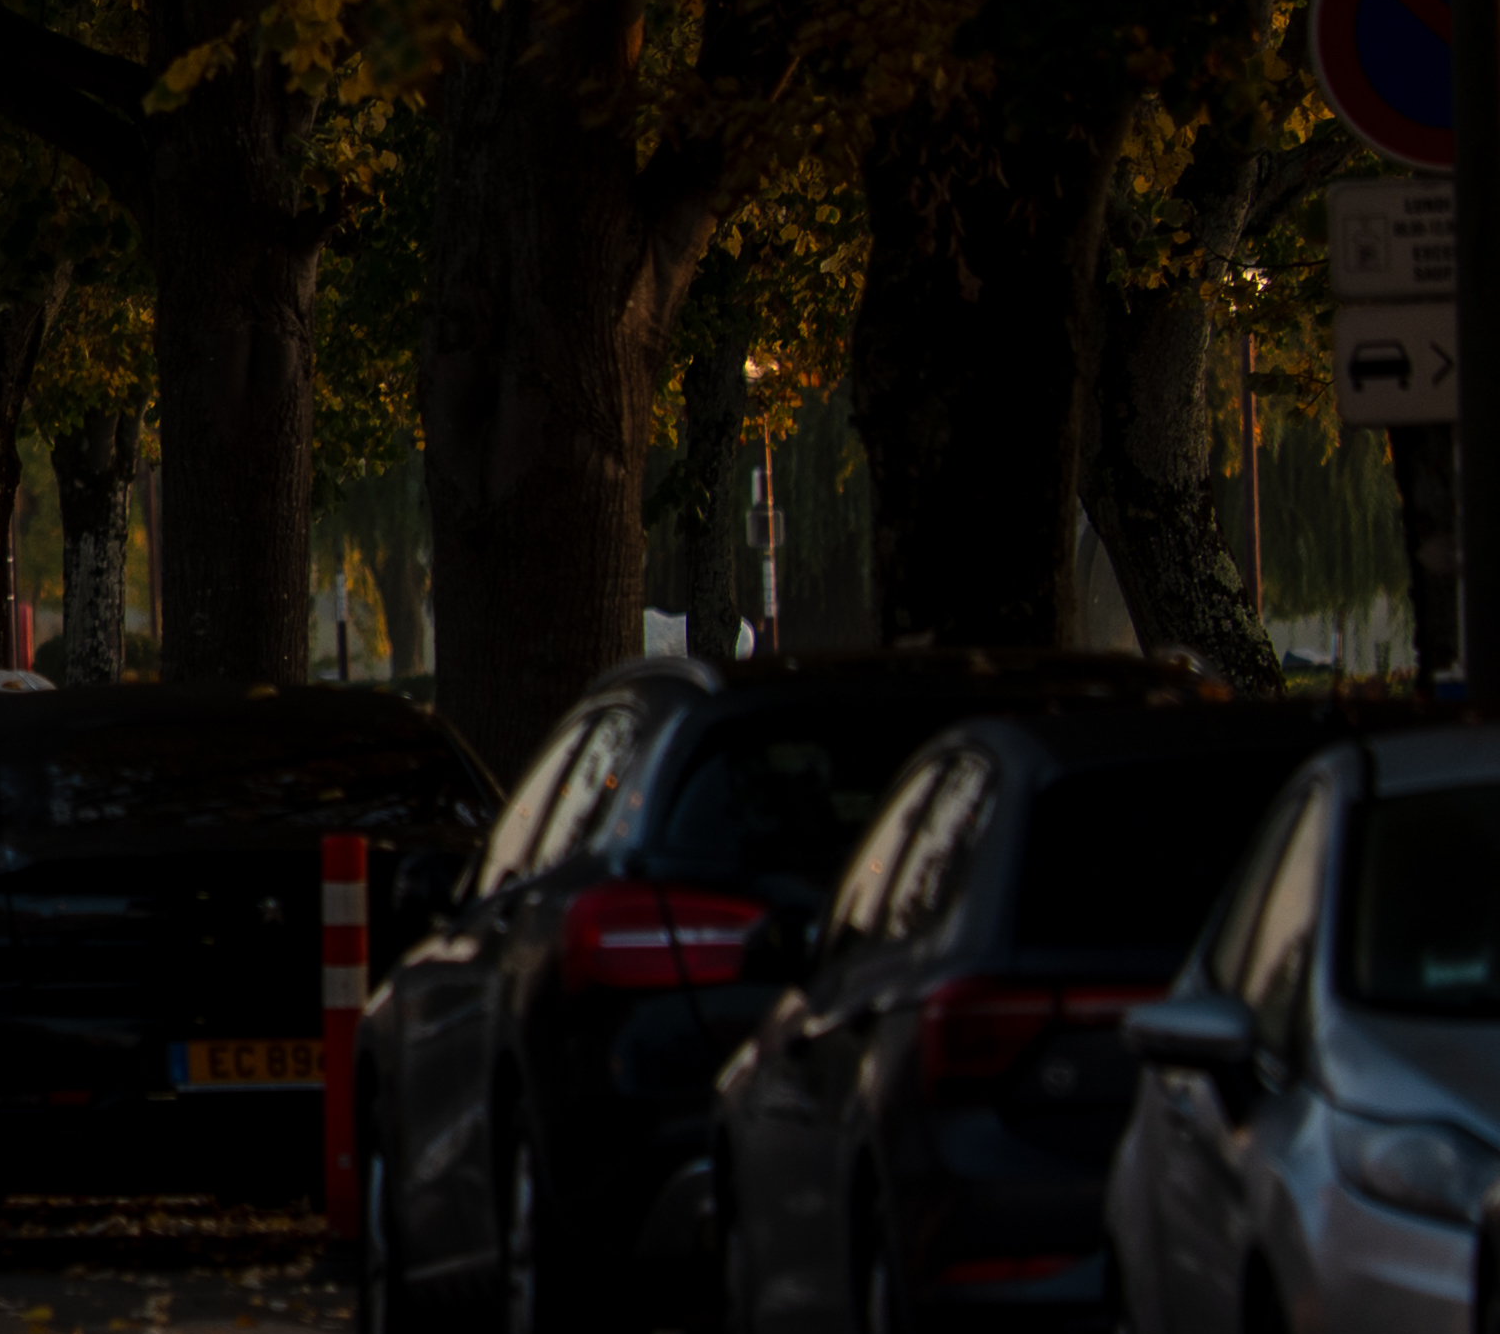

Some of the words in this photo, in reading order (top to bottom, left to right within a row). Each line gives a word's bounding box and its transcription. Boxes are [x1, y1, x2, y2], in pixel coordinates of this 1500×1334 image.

[1412, 245, 1457, 262] EXCE
[210, 1045, 255, 1078] EC
[267, 1045, 324, 1078] 89
